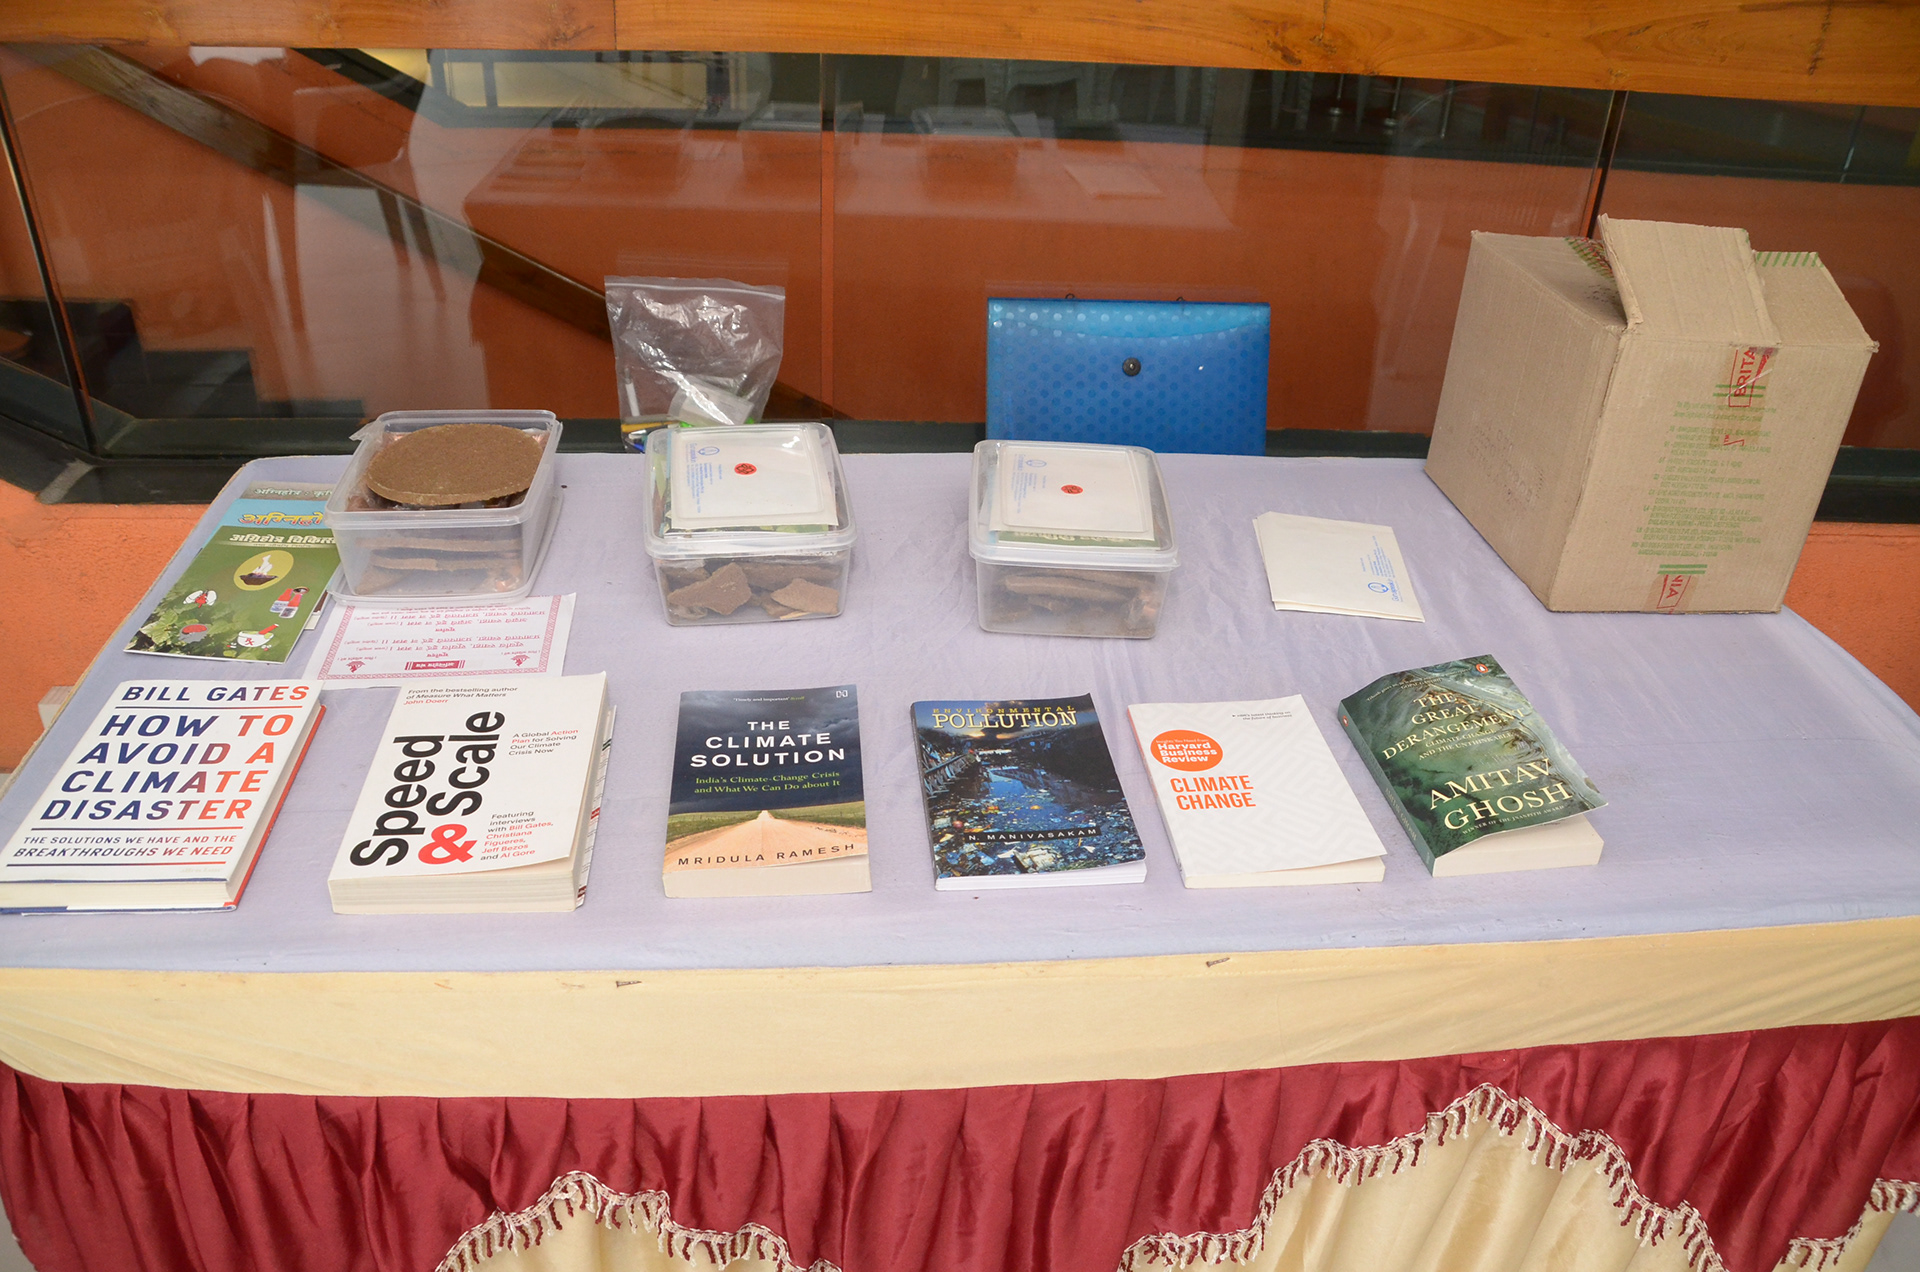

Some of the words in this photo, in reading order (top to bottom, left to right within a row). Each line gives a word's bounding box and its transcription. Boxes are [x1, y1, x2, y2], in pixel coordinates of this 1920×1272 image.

[122, 687, 191, 700] BILL
[207, 686, 309, 701] GATES
[1414, 692, 1457, 708] THE
[933, 705, 1075, 713] ENVIRONMENTAL
[1412, 704, 1478, 724] GREAT
[100, 715, 219, 736] HOW
[238, 715, 294, 736] TO
[748, 721, 790, 731] THE
[932, 711, 1077, 729] POLLUTION
[705, 733, 831, 749] CLIMATE
[1382, 708, 1529, 760] DERANGEMENT
[1426, 736, 1460, 747] CLIMATE
[1462, 729, 1496, 740] CHANGE
[78, 743, 231, 764] AVOID
[245, 742, 274, 764] A
[1157, 742, 1211, 750] Harvard
[1420, 749, 1436, 760] AND
[1455, 732, 1513, 748] UNTHINKABLE
[426, 711, 505, 816] Scale
[690, 749, 845, 767] SOLUTION
[61, 770, 269, 792] CLIMATE
[694, 786, 712, 794] and
[715, 785, 741, 793] What
[802, 781, 829, 789] about
[730, 774, 809, 783] Climate-Change
[1170, 775, 1253, 792] CLIMATE
[1430, 758, 1551, 810] AMITAV
[40, 800, 252, 820] DISASTER
[350, 735, 446, 867] Speed
[1176, 792, 1256, 810] CHANGE
[1444, 782, 1573, 830] GHOSH
[490, 818, 535, 826] interviews
[1463, 823, 1487, 834] WINNER
[1543, 806, 1565, 814] AWARD
[50, 836, 121, 844] SOLUTIONS
[486, 831, 532, 839] Christiana
[987, 828, 1096, 840] MANIVASAKAM
[14, 848, 159, 857] BREAKTHROUGHS
[163, 847, 189, 856] WE
[191, 846, 233, 855] NEED
[418, 824, 478, 865] &
[678, 854, 765, 866] MRIDULA
[777, 844, 855, 860] RAMESH
